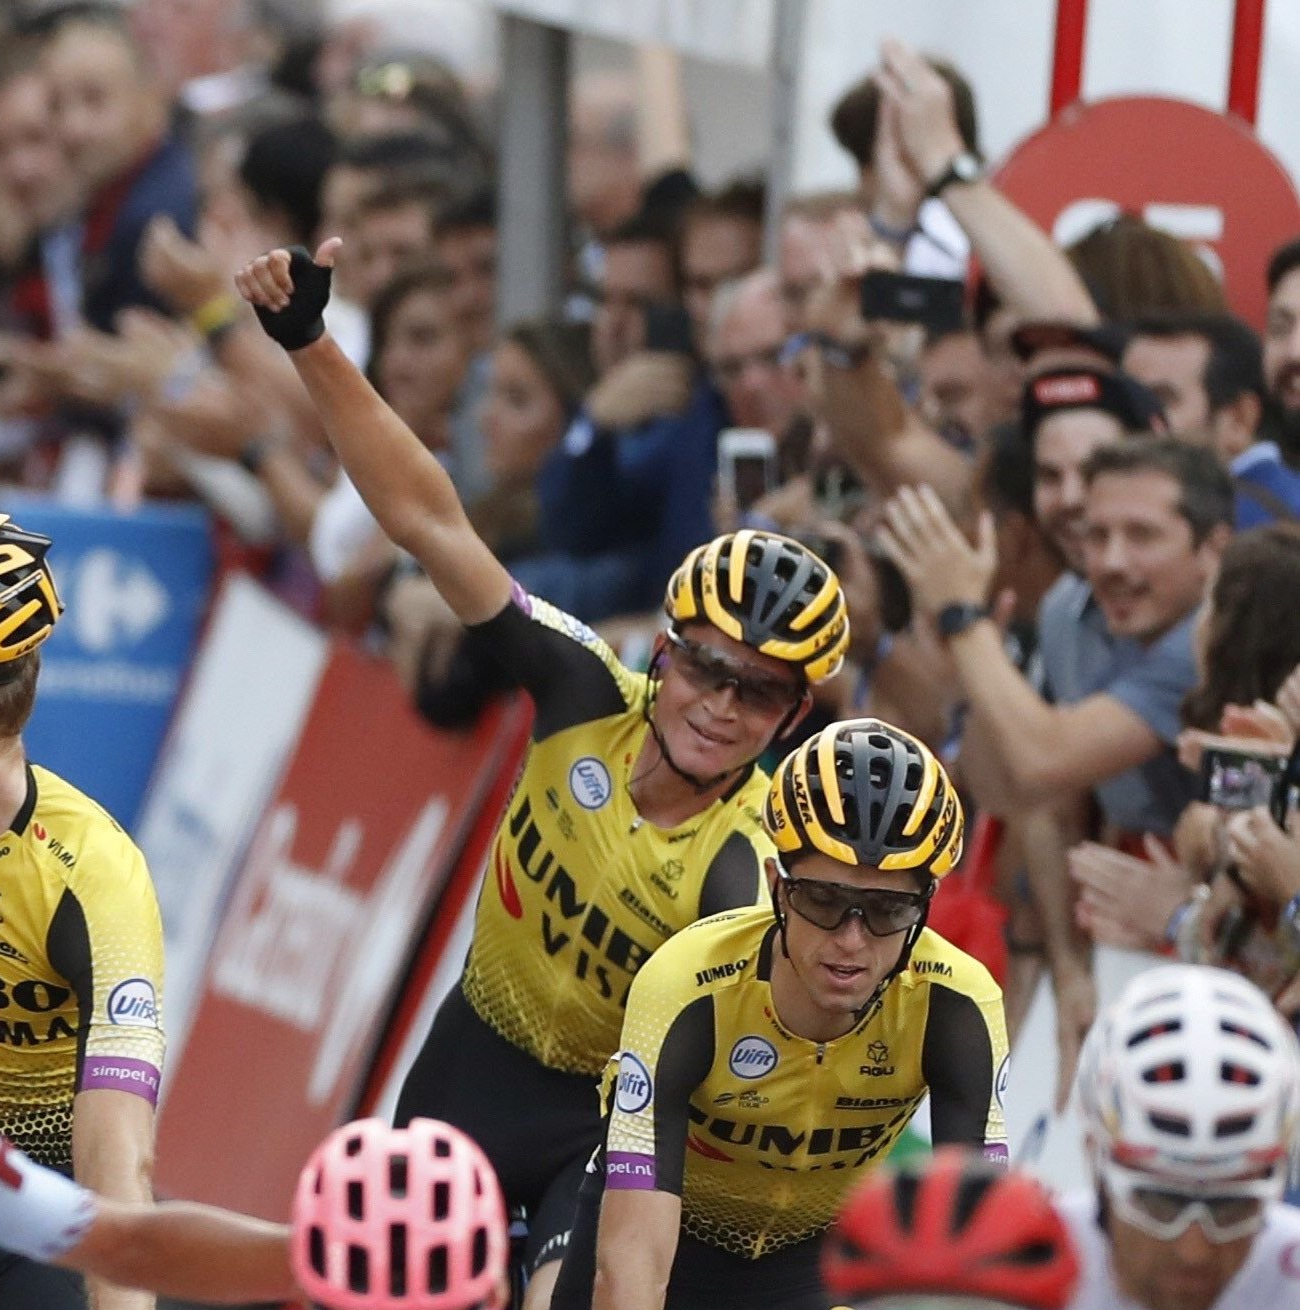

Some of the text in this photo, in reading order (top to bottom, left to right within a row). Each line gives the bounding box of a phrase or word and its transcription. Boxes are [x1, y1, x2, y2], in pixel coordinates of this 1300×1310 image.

[509, 793, 653, 976] JUMB
[695, 959, 748, 987] JUMBO
[913, 961, 953, 978] VISMA
[734, 1048, 775, 1066] Vifit
[860, 1065, 894, 1076] AGU
[607, 1161, 653, 1177] pel.nl
